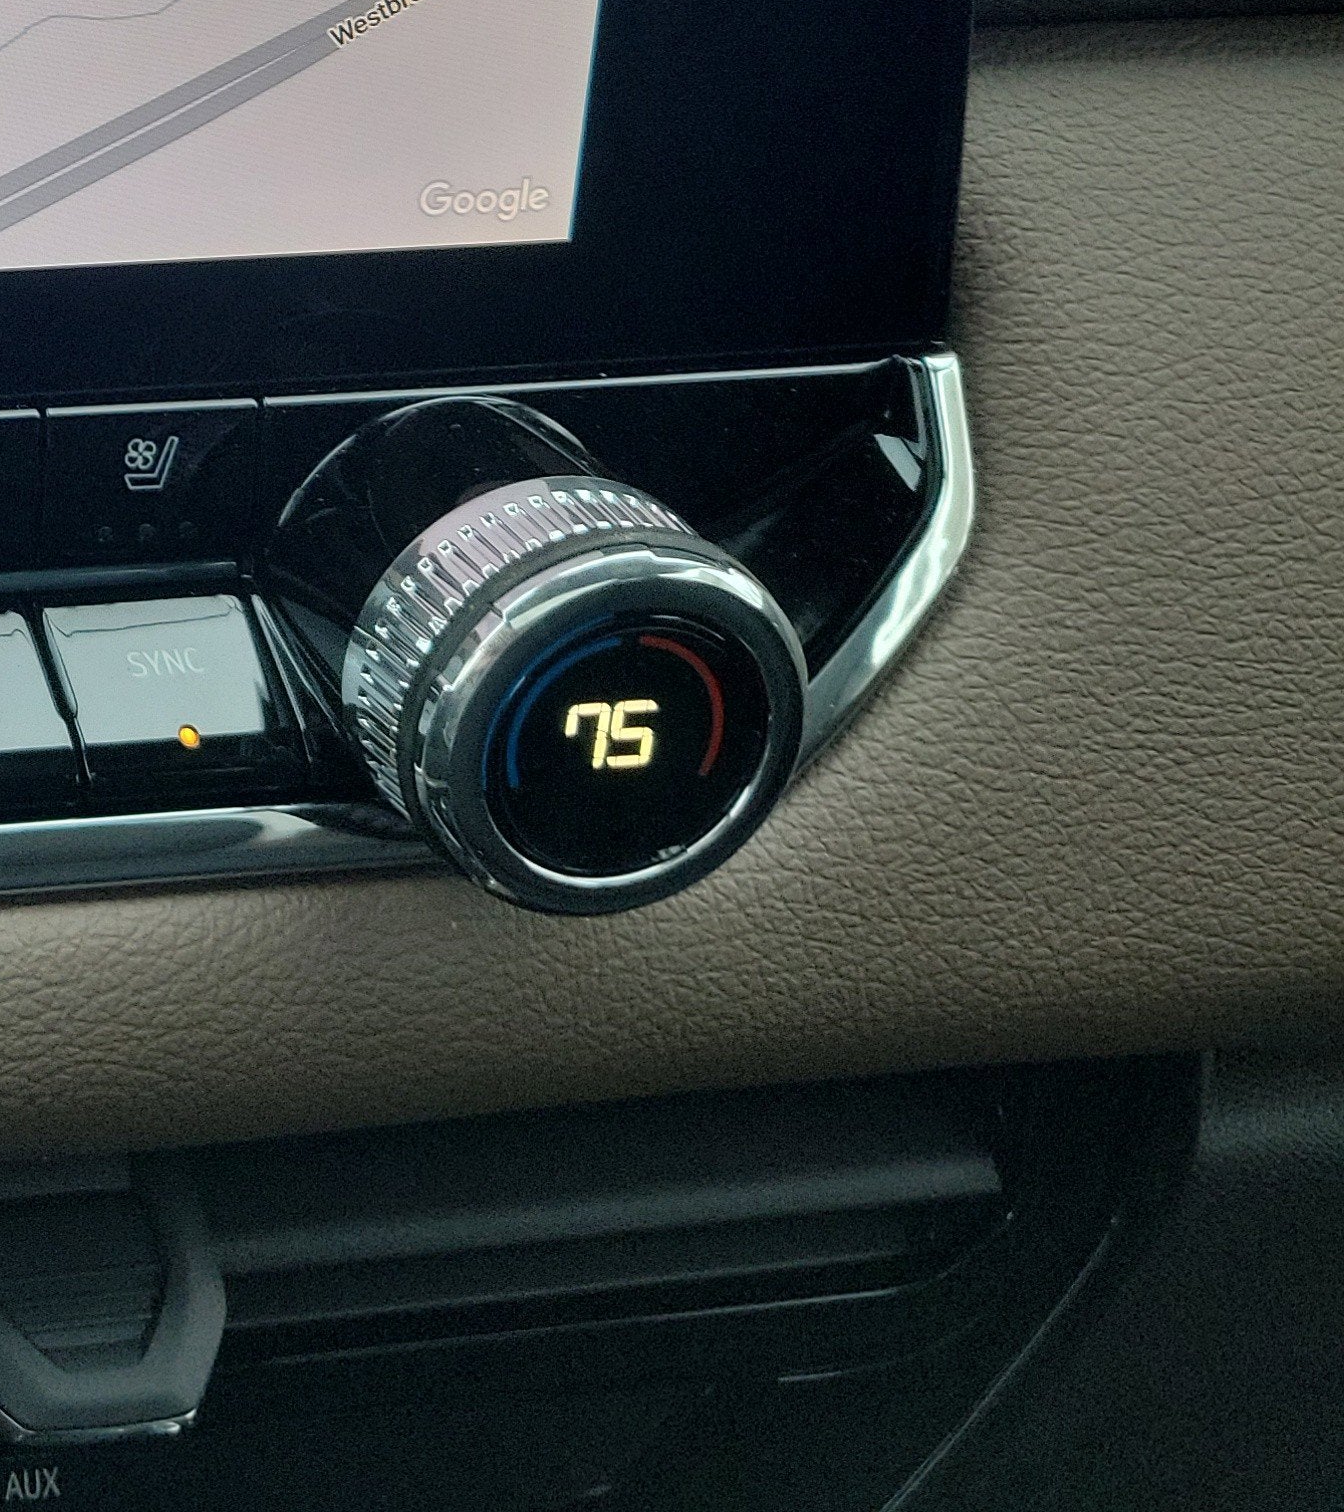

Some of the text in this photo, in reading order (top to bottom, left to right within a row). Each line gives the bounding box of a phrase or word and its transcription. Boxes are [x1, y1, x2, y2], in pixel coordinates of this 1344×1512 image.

[419, 178, 549, 221] Google
[127, 648, 204, 679] SYNC
[565, 699, 658, 769] 75
[5, 1467, 61, 1500] AUX
